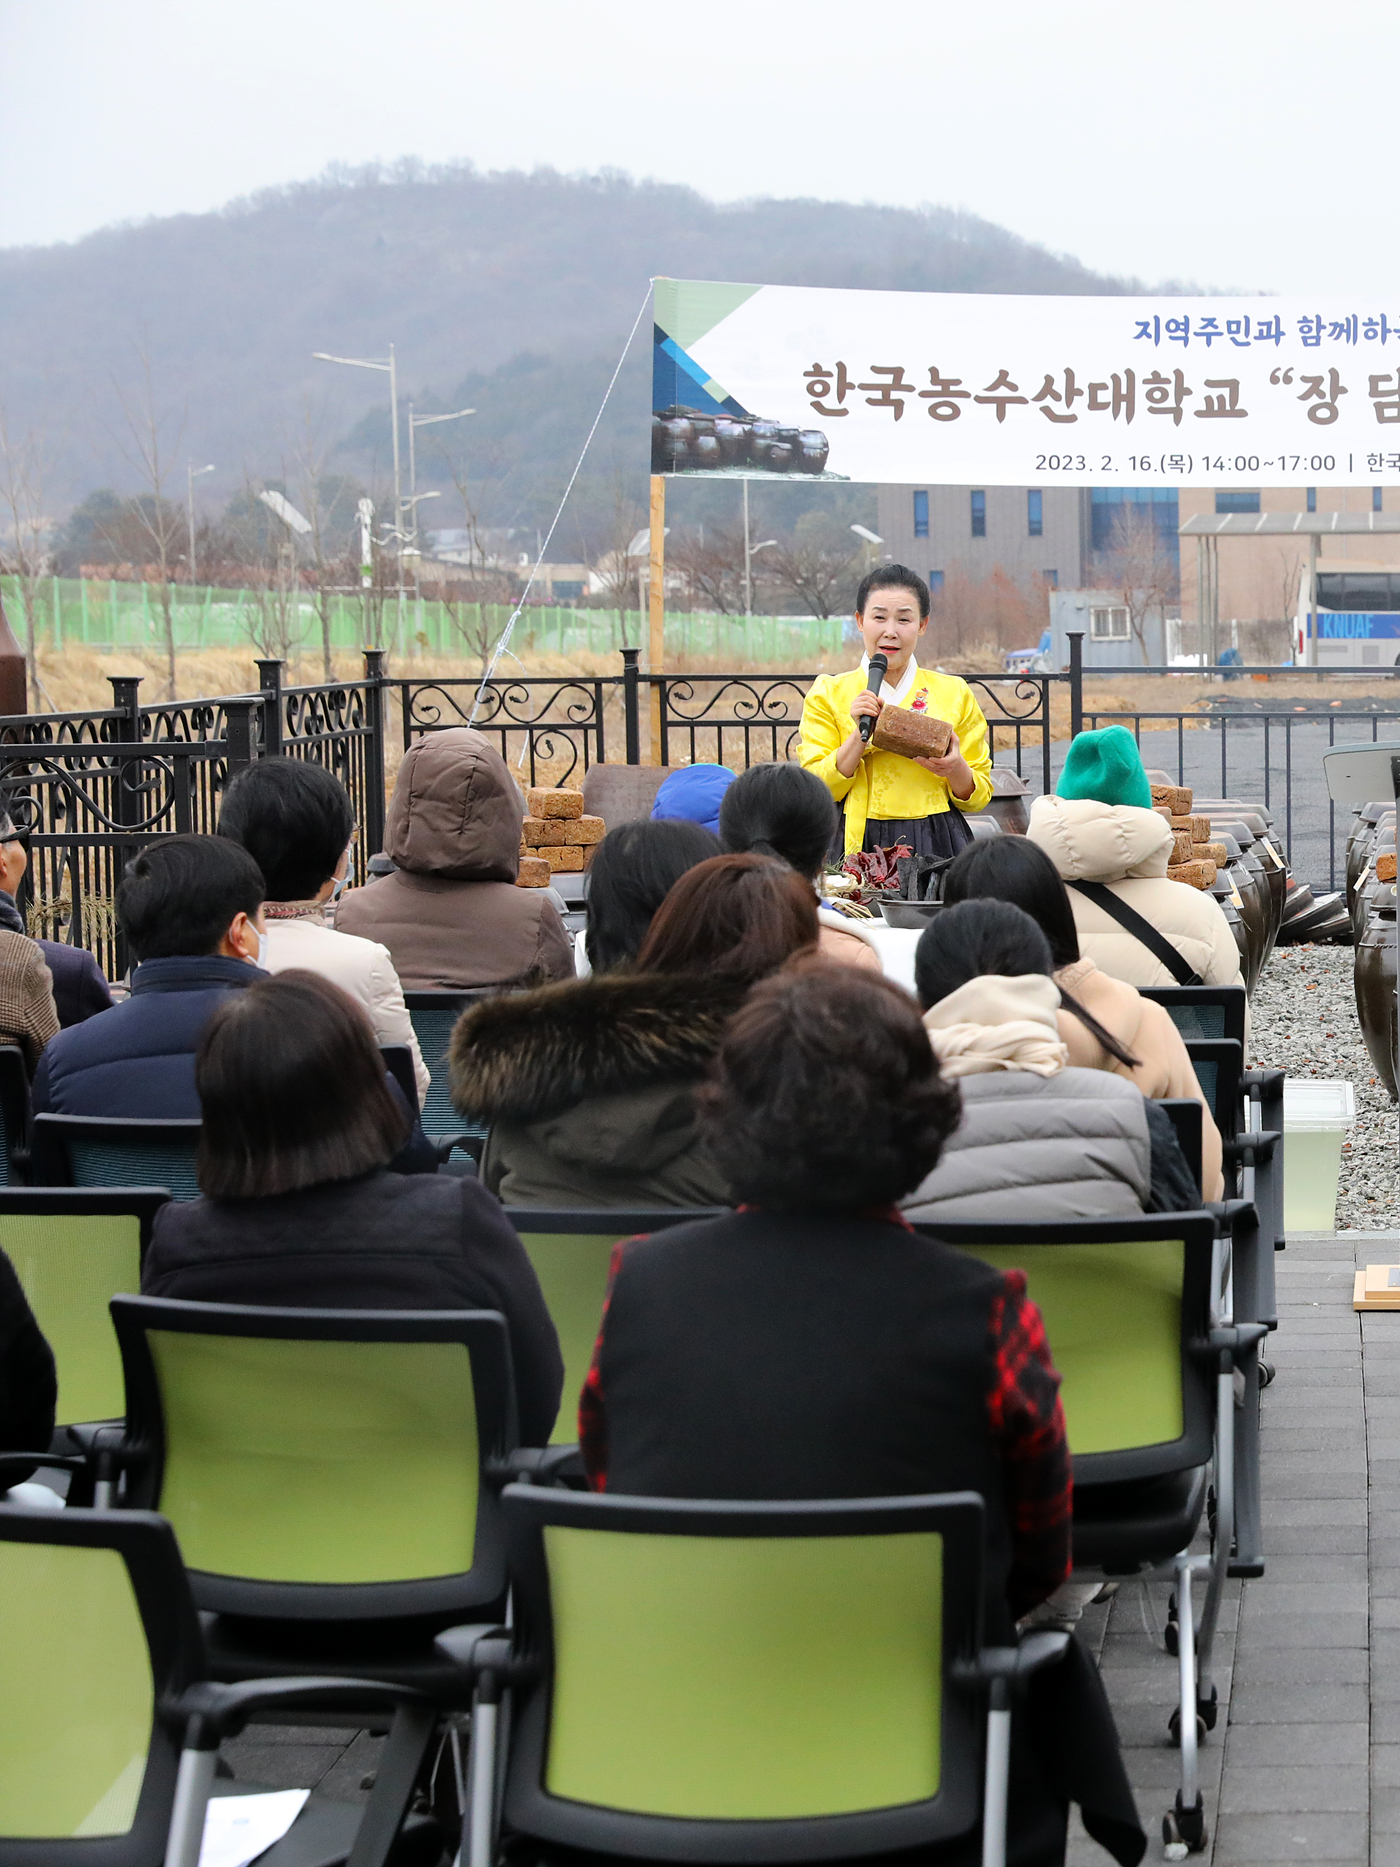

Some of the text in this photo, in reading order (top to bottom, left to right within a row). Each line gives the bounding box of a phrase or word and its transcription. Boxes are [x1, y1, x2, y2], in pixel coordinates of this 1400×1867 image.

[1133, 314, 1286, 349] 지역주민과
[802, 360, 1249, 427] 한국농수산대학교
[1035, 454, 1093, 472] 2023.
[1100, 455, 1119, 472] 2.
[1128, 454, 1193, 475] 16.(목)
[1201, 454, 1336, 472] 14:00~17:00
[1323, 613, 1374, 639] KNUAF
